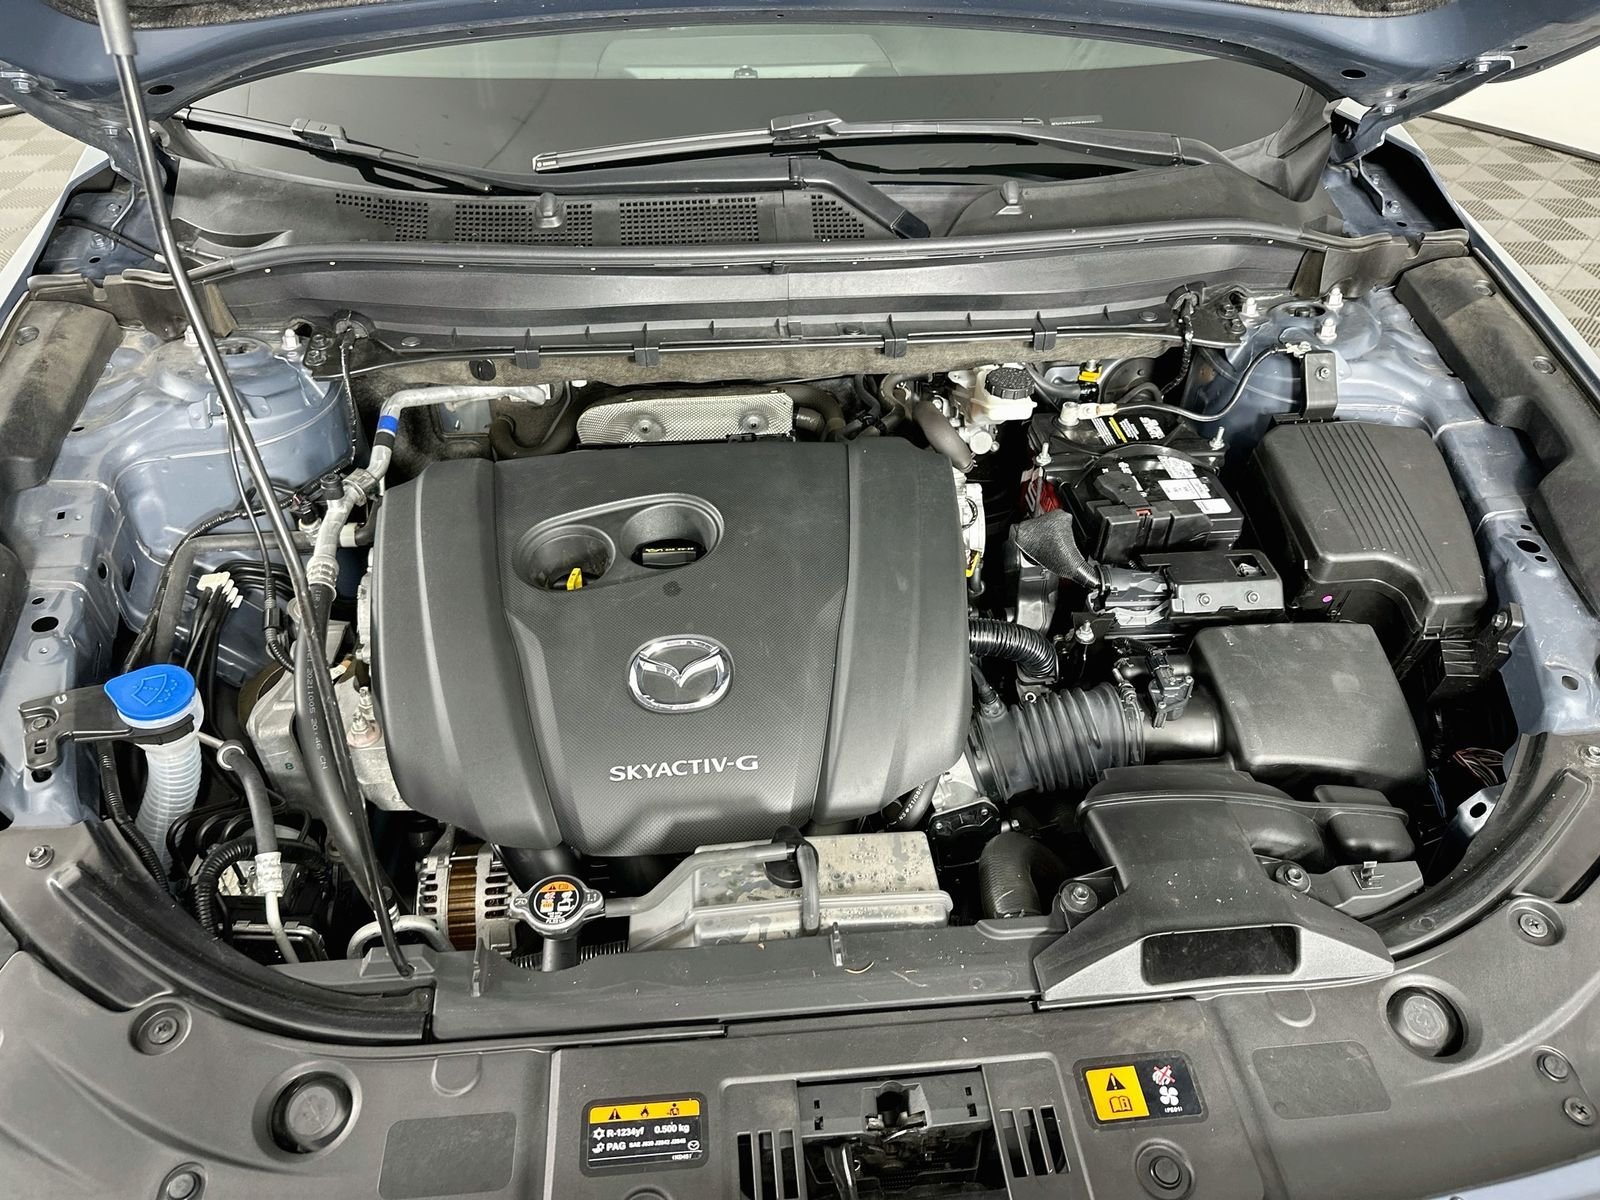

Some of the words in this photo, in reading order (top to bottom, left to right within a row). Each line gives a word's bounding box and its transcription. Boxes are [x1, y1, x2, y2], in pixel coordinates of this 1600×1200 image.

[609, 755, 759, 782] SKYACTIV-G
[606, 1126, 644, 1137] R-1234yf
[654, 1124, 677, 1134] 0.500
[678, 1123, 690, 1133] kg
[606, 1142, 626, 1151] PAG
